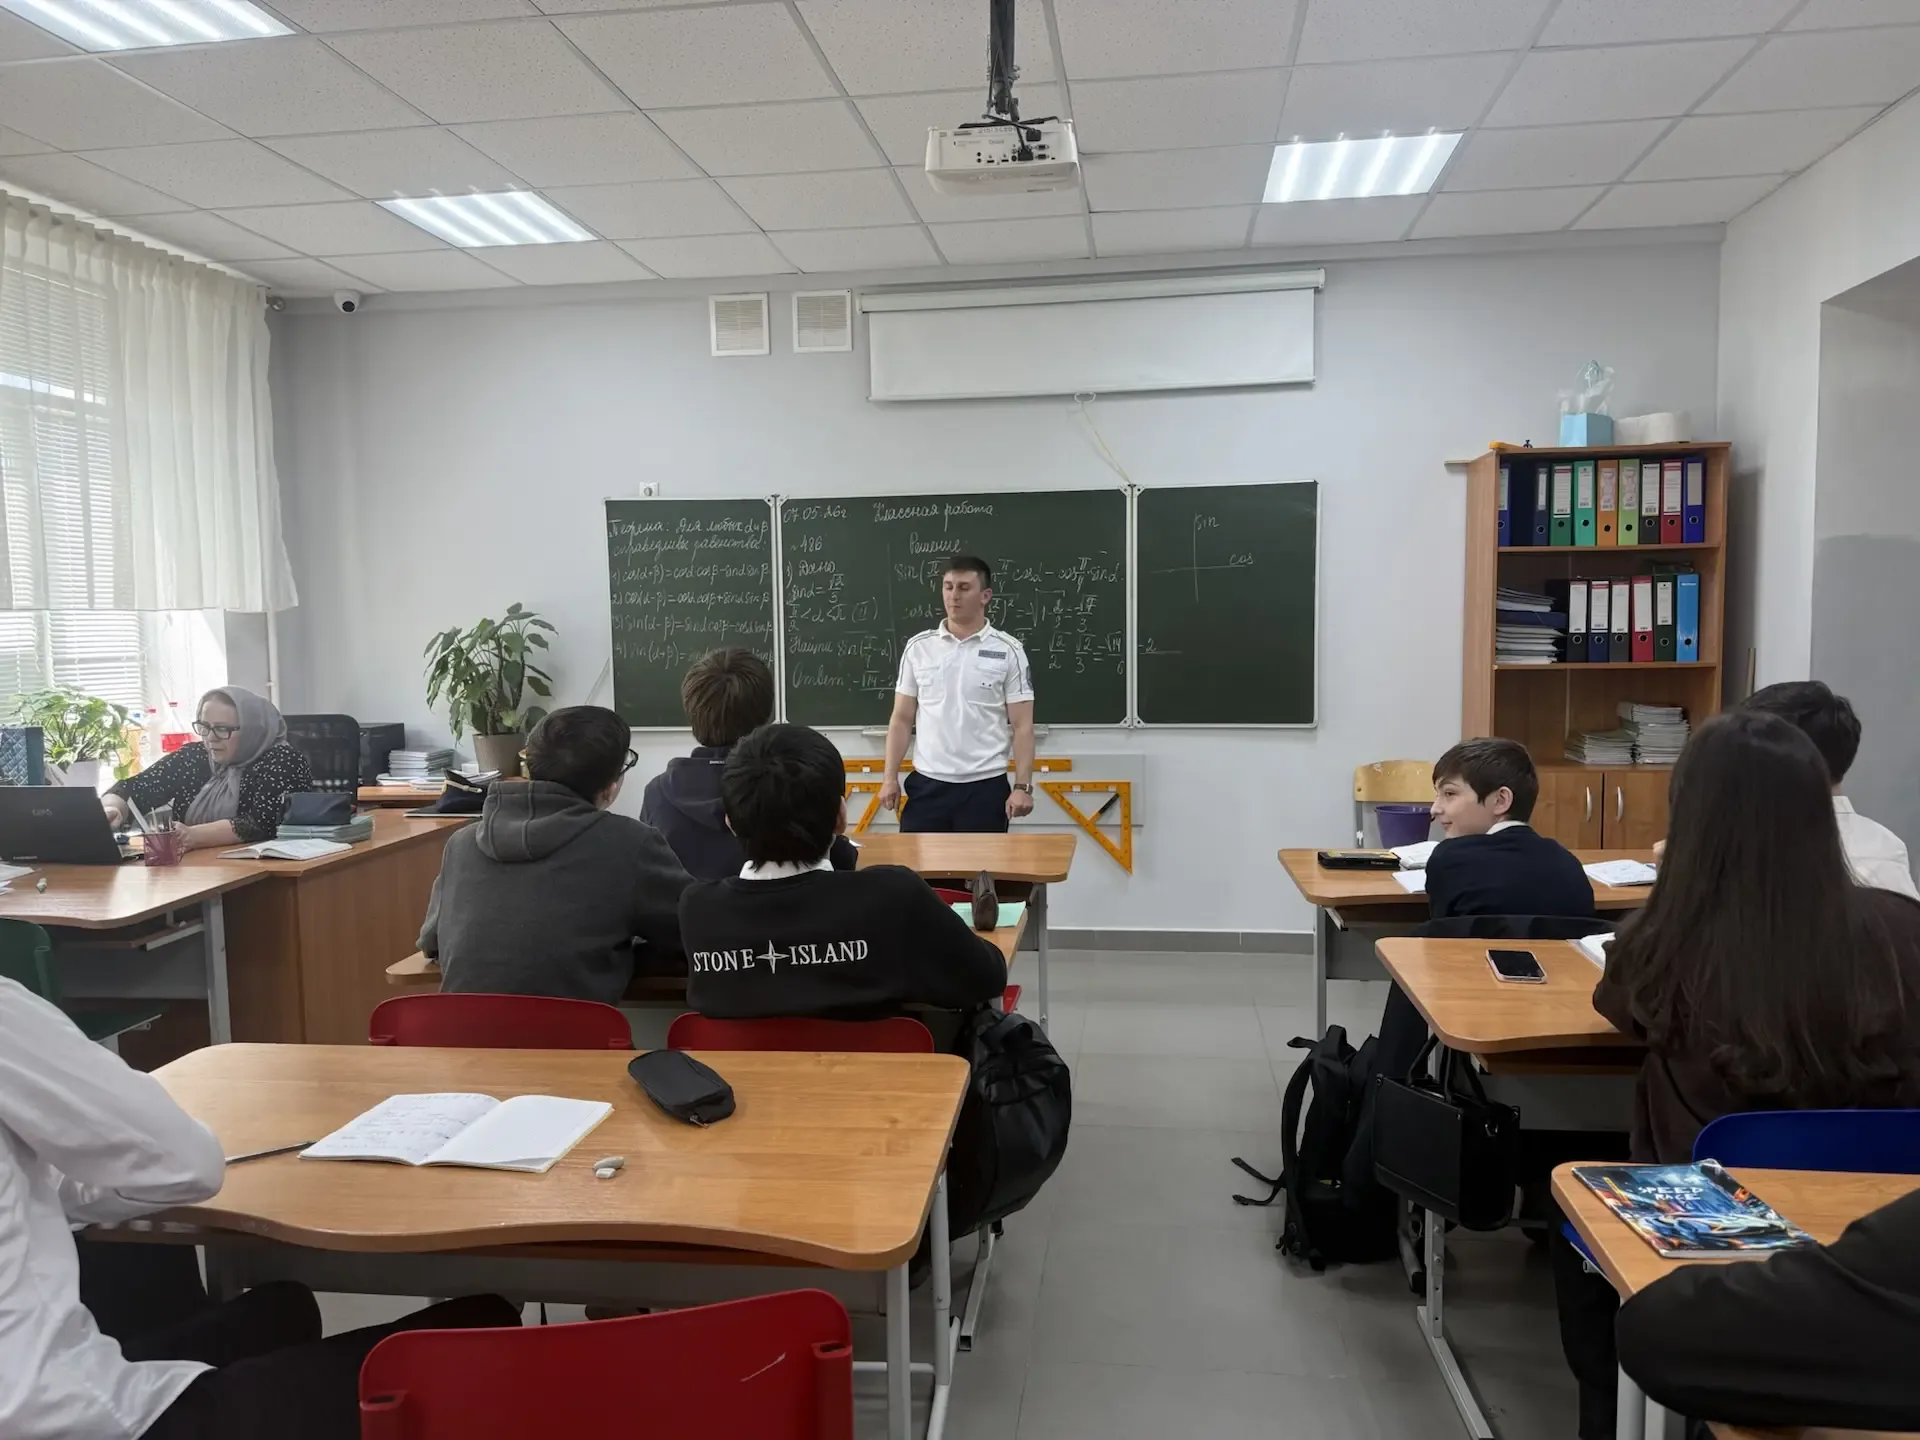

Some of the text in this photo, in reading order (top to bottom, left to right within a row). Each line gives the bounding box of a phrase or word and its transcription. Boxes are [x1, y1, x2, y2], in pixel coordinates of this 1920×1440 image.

[873, 502, 939, 522] Классная
[676, 517, 702, 534] Для
[707, 517, 743, 532] любых
[1195, 514, 1220, 530] sin
[1230, 552, 1254, 566] cos
[693, 939, 869, 973] STONE ISLAND
